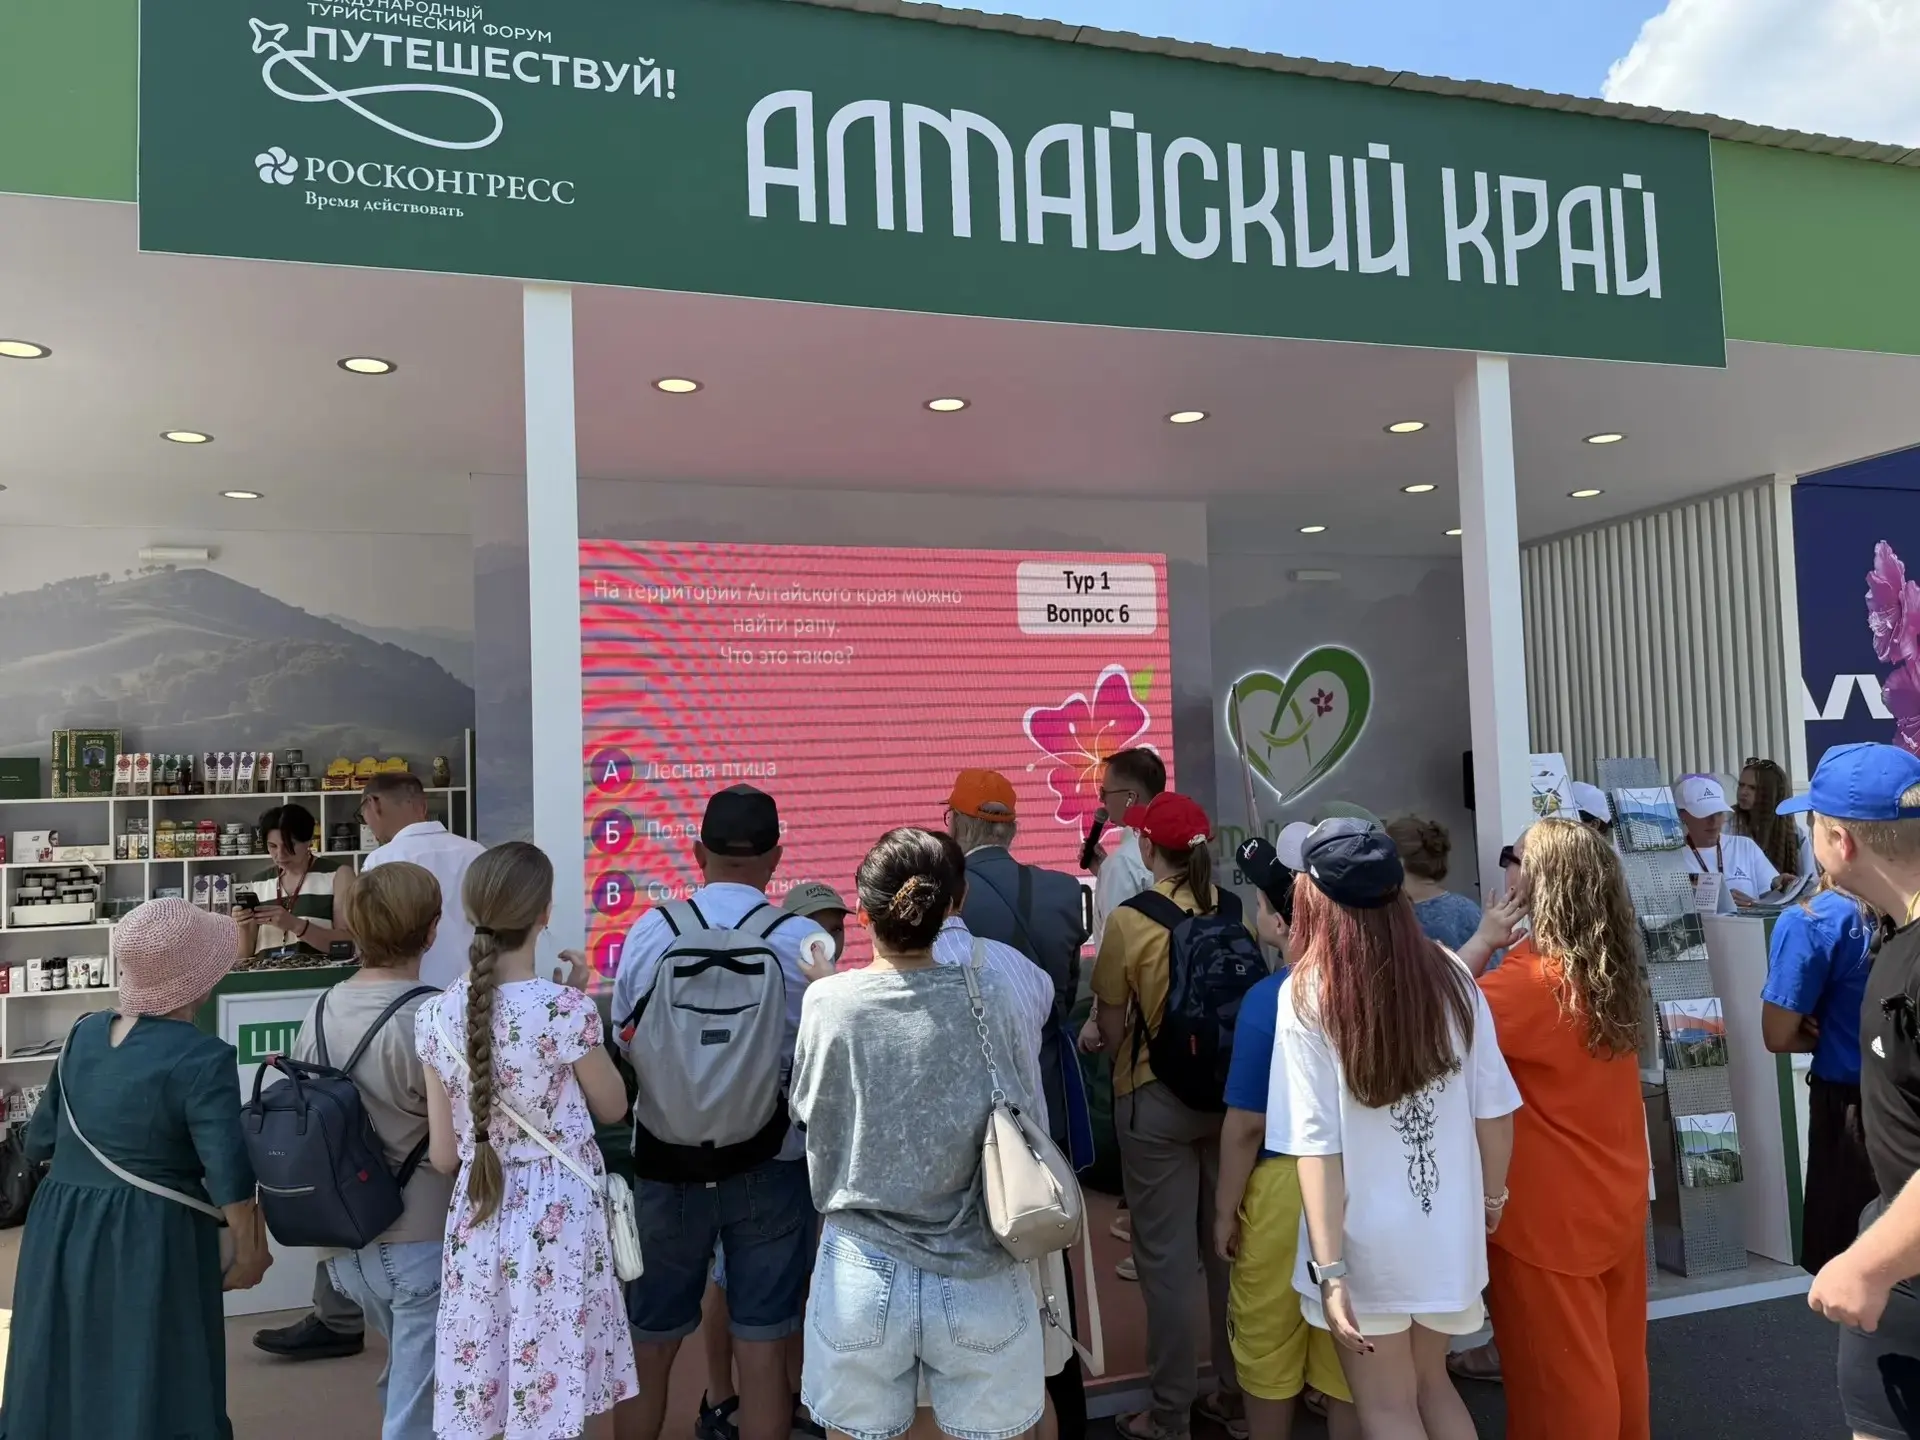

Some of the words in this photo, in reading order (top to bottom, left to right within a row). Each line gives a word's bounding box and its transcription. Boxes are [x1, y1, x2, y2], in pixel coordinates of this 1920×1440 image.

[306, 2, 476, 34] ТУРИСТИЧЕСКИЙ
[483, 23, 552, 44] ФОРУМ
[305, 25, 676, 100] ПУТЕШЕСТВУЙ!
[304, 156, 576, 205] РОСКОНГРЕСС
[305, 191, 359, 211] Время
[363, 199, 465, 218] действовать
[747, 90, 1410, 277] АЛТАЙСКИЙ
[1441, 167, 1662, 298] КРАЙ
[593, 580, 620, 599] На
[627, 582, 741, 604] территории
[747, 582, 851, 603] Алтайского
[857, 588, 897, 606] края
[903, 589, 962, 604] можно
[1063, 570, 1095, 594] Тур
[1101, 571, 1111, 590] 1
[732, 613, 787, 633] найти
[793, 617, 840, 637] рапу.
[1046, 603, 1114, 627] Вопрос
[1119, 604, 1130, 623] 6
[720, 644, 753, 664] Что
[759, 649, 788, 665] это
[793, 645, 854, 665] такое?
[602, 759, 621, 783] А
[644, 761, 716, 781] Лесная
[722, 761, 777, 780] птица
[605, 820, 620, 844] Б
[605, 882, 621, 906] В
